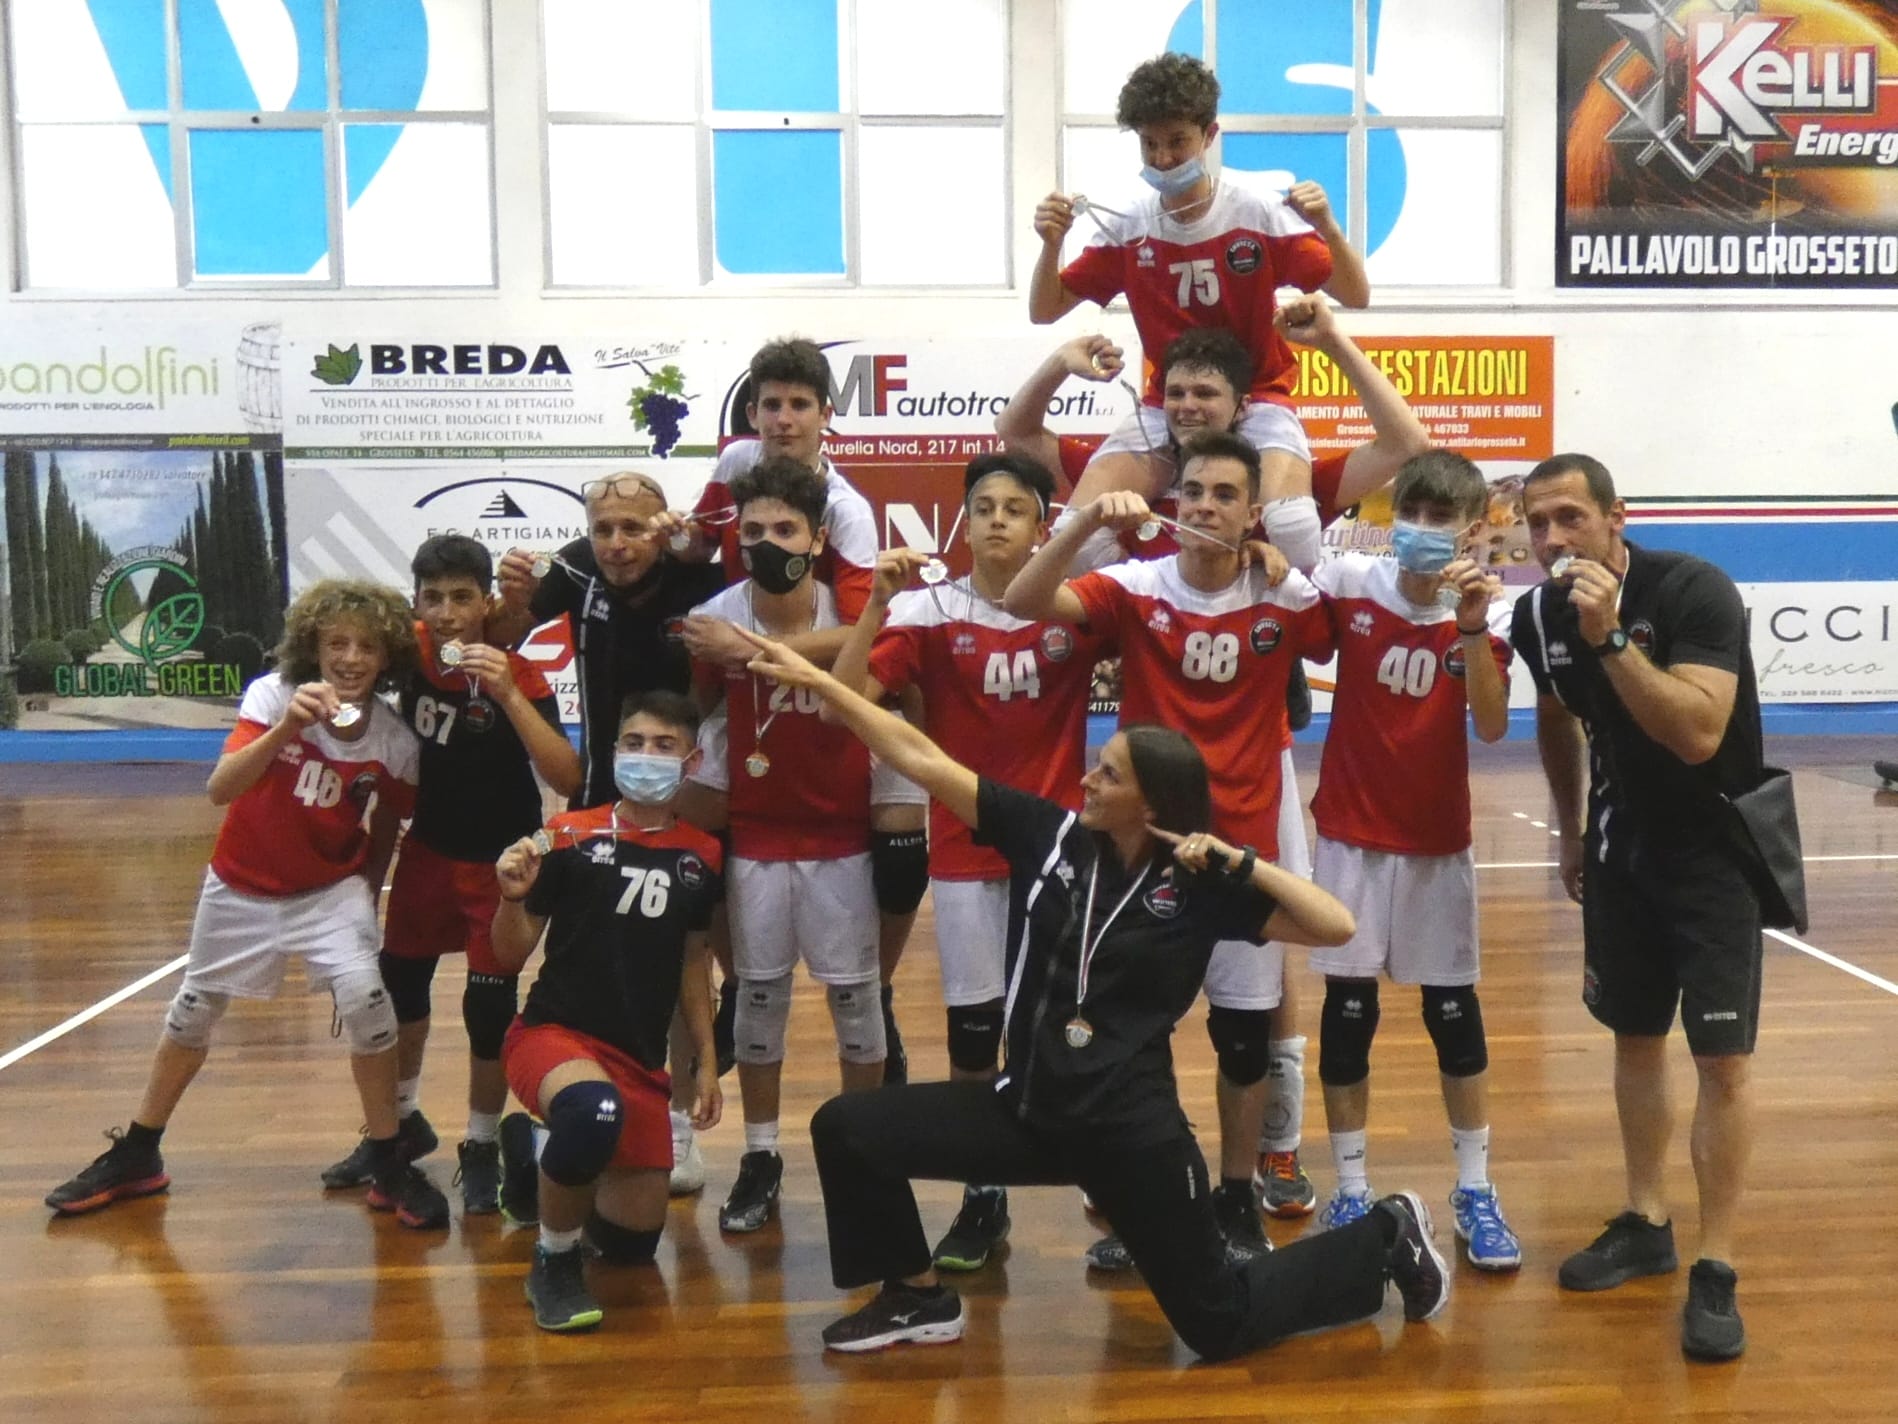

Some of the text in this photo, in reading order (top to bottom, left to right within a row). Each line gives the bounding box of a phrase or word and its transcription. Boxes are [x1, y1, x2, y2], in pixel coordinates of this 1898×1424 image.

[1795, 125, 1898, 164] Energ
[1571, 235, 1898, 275] PALLAVOLO GROSSETO
[1168, 258, 1220, 308] 75
[370, 344, 572, 375] BREDA
[0, 345, 219, 412] andolfini
[371, 377, 438, 388] PRODOTTI
[445, 377, 466, 388] PER
[55, 402, 79, 410] PER
[296, 414, 311, 425] DI
[315, 414, 379, 425] PRODOTTI
[445, 414, 511, 425] BIOLOGICI
[515, 414, 522, 425] E
[526, 413, 605, 425] NUTRIZIONE
[486, 397, 501, 409] AL
[504, 397, 575, 409] DETTAGLIO
[897, 390, 1096, 417] autotraorti
[1296, 405, 1340, 419] AMENTO
[1461, 405, 1492, 419] TRAVI
[1494, 405, 1502, 418] E
[1503, 405, 1543, 418] MOBILI
[359, 430, 543, 441] SPECIALE PER L'AGRICOLTURA
[818, 439, 874, 455] Aurelia
[927, 439, 957, 455] 217
[472, 527, 591, 541] ARTIGIANA
[1182, 631, 1239, 683] 88
[1377, 645, 1437, 698] 40
[1760, 648, 1885, 684] fresco
[54, 663, 241, 698] GLOBAL GREEN
[983, 649, 1040, 702] 44
[415, 695, 457, 746] 67
[615, 866, 671, 918] 76
